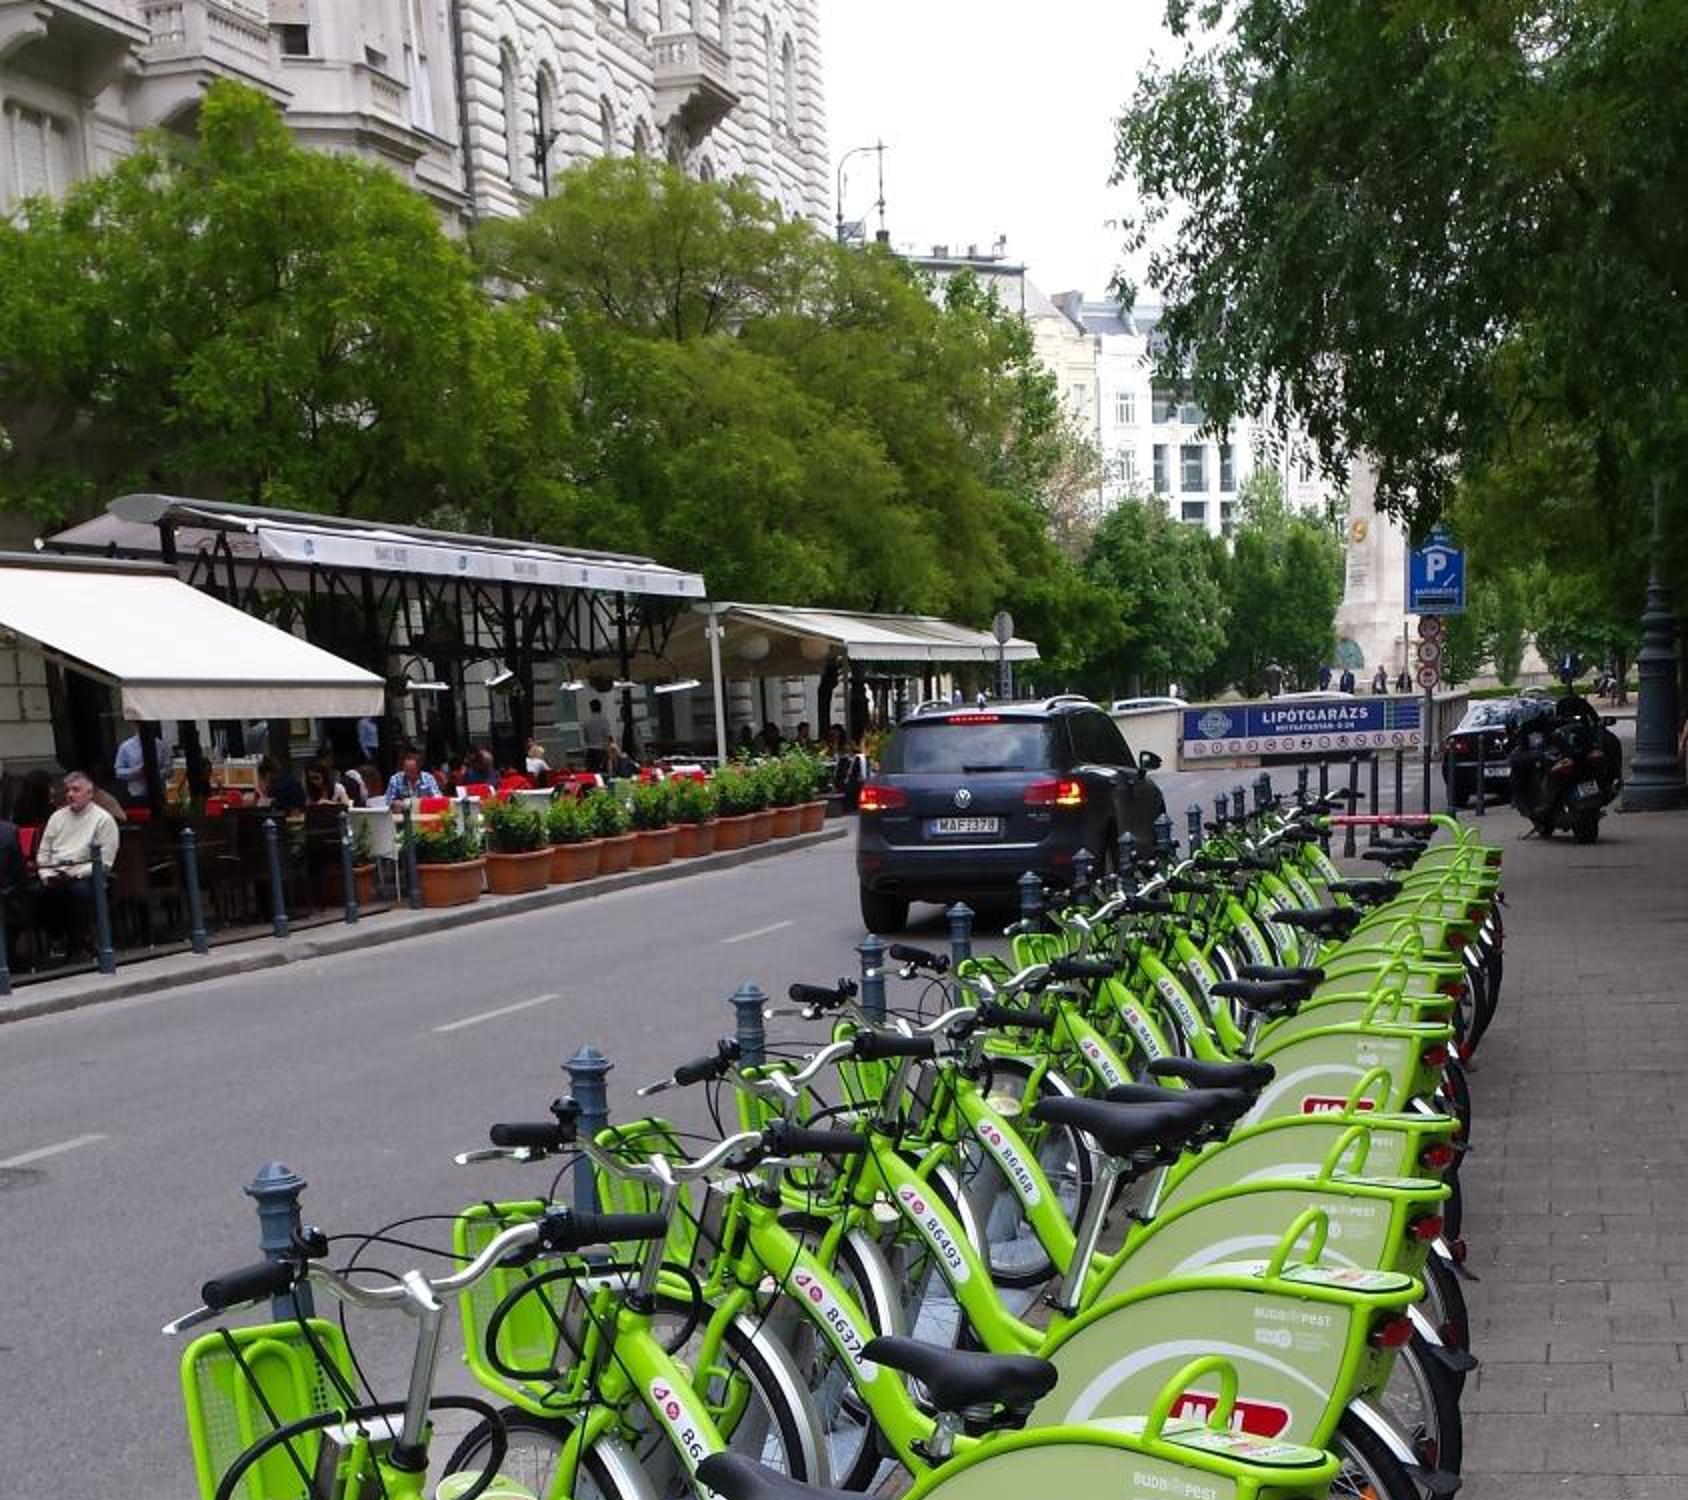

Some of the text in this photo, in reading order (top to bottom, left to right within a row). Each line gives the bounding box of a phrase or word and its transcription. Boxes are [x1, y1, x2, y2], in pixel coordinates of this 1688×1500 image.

[1426, 552, 1447, 582] P
[1262, 706, 1369, 724] LIPÓTGARÁZS
[926, 1217, 961, 1269] 86493
